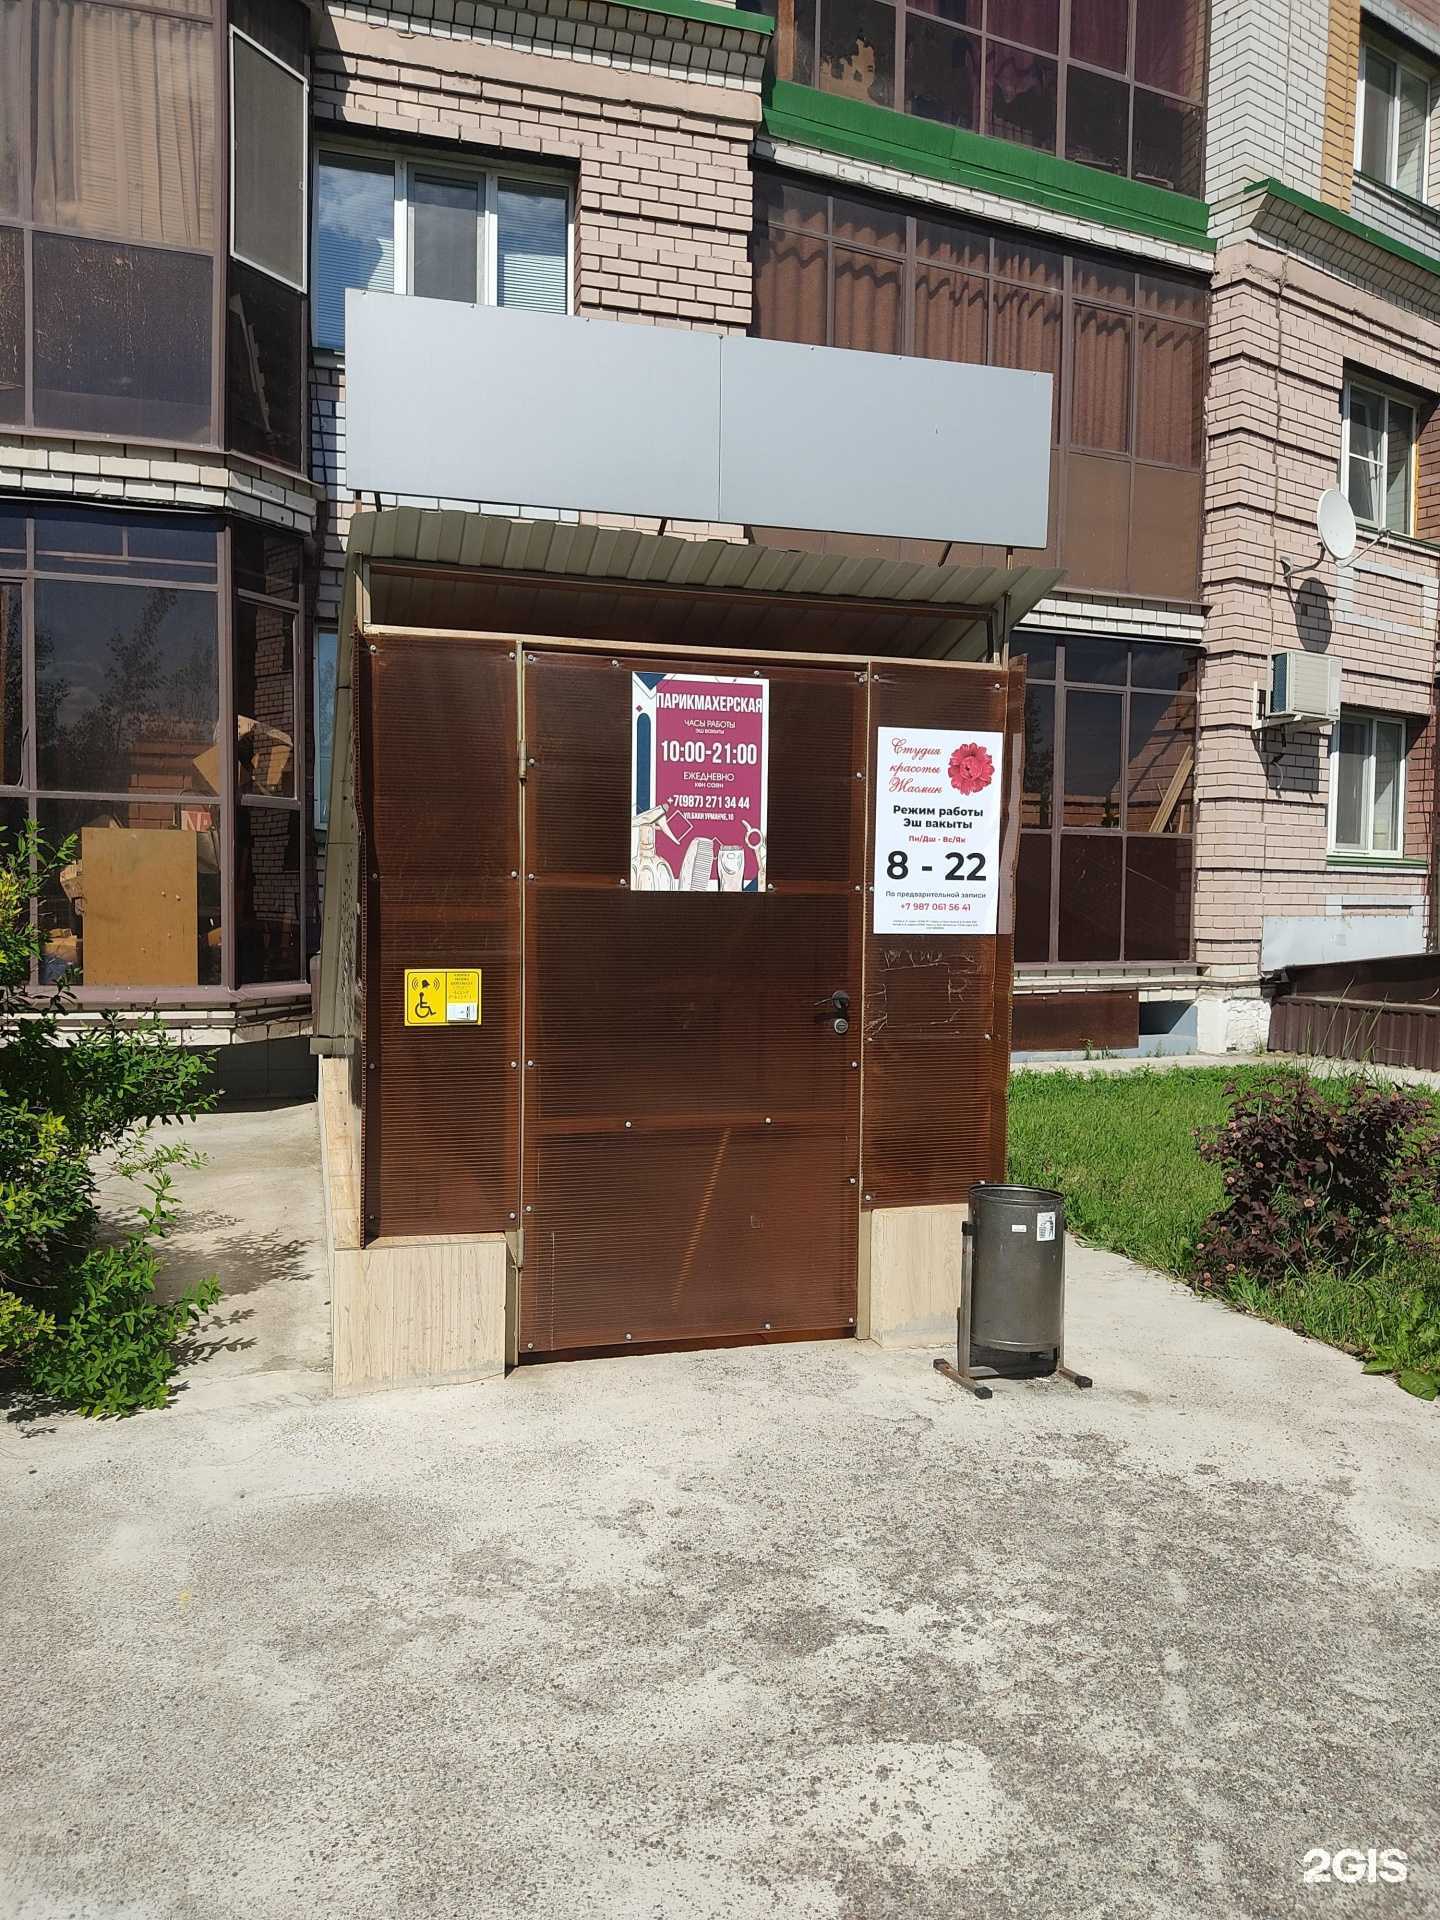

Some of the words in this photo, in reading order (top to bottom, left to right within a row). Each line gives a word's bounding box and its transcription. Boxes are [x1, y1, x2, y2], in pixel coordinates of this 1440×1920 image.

[656, 692, 763, 713] ПАРИКМАХЕРСКАЯ
[684, 719, 705, 727] ЧАСЫ
[706, 720, 736, 729] РАБОТЫ
[661, 740, 757, 764] 10:00-21:00
[892, 737, 942, 760] Студия
[889, 762, 941, 776] красоты
[683, 771, 735, 782] ЕЖЕДНЕВНО
[705, 795, 722, 809] 271
[724, 796, 737, 809] 34
[738, 796, 750, 809] 44
[893, 805, 935, 815] Режим
[939, 807, 983, 817] работы
[903, 818, 922, 827] Эш
[925, 819, 972, 829] вакыты
[887, 850, 909, 880] 8
[945, 852, 986, 881] 22
[901, 902, 911, 910] +7
[913, 902, 929, 911] 987
[932, 903, 947, 911] 061
[948, 903, 959, 911] 56
[962, 903, 971, 911] 41
